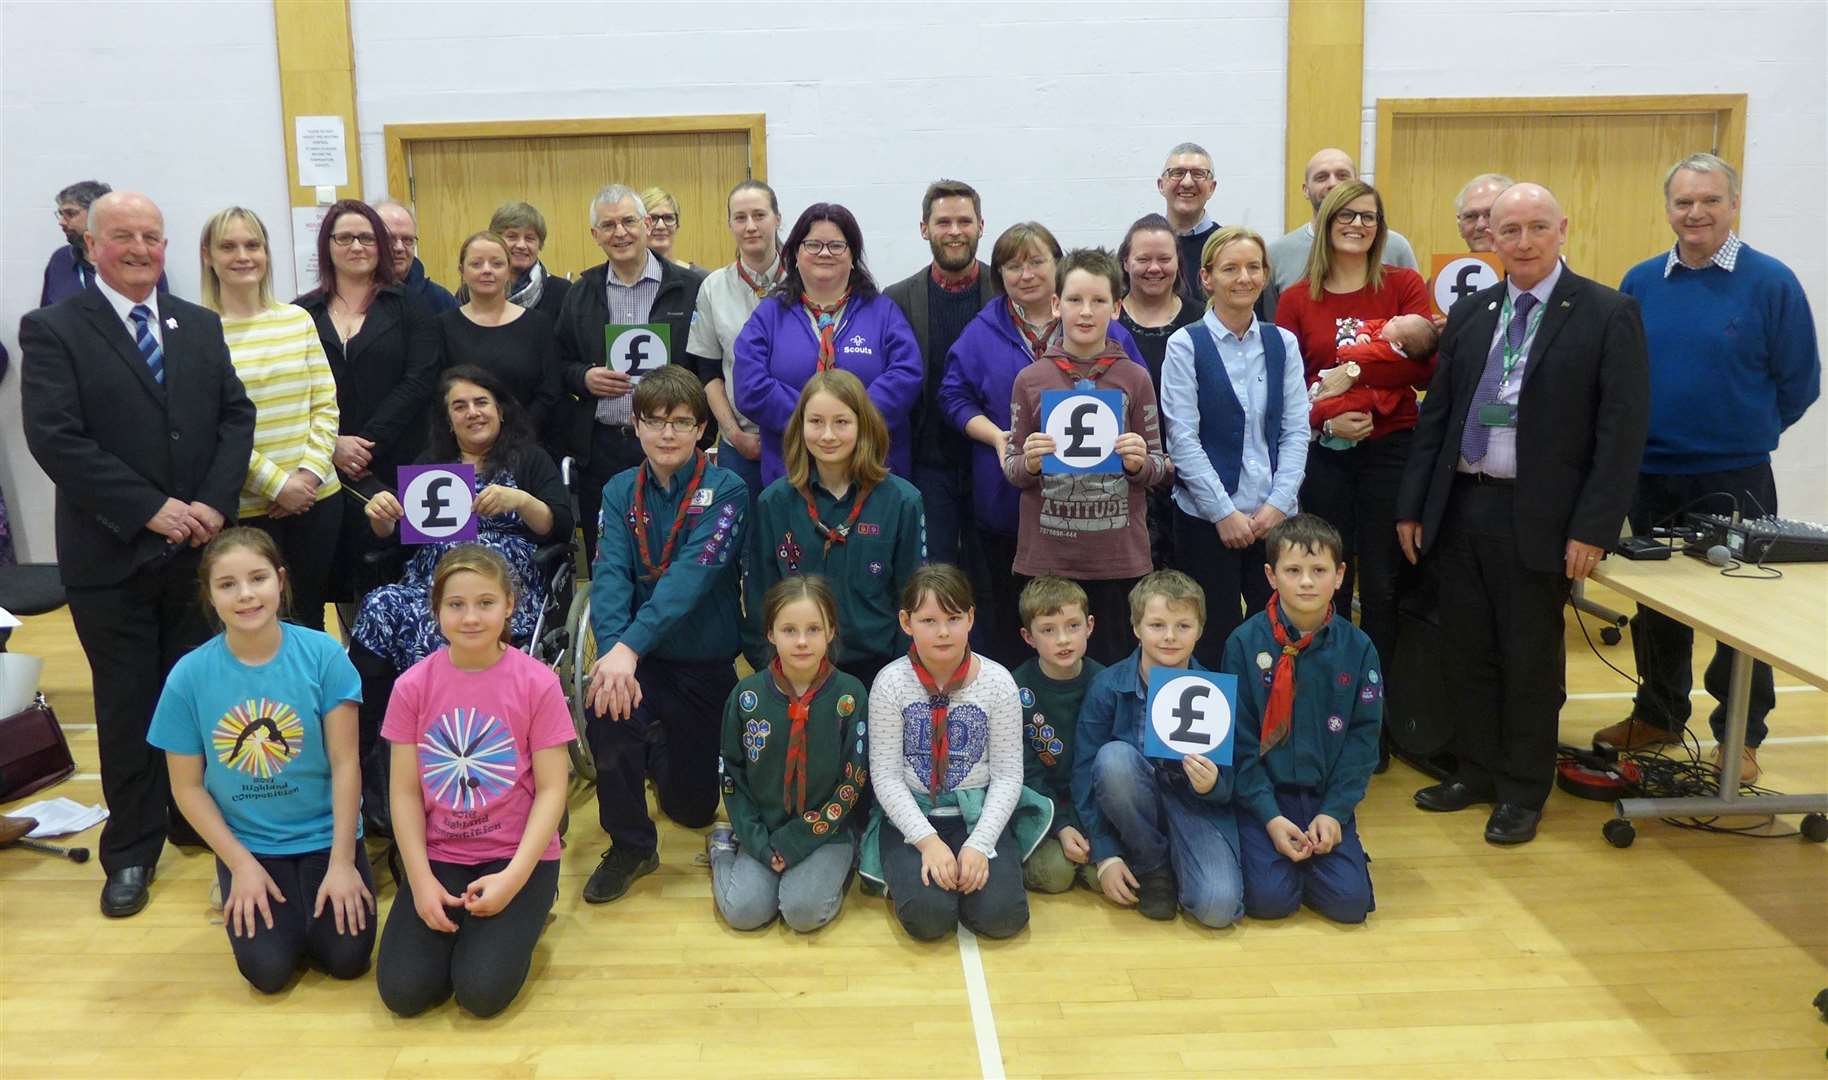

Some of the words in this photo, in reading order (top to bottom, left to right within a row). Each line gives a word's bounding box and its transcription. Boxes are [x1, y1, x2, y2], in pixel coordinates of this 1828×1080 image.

[844, 346, 872, 355] Scouts
[1064, 403, 1101, 457] £
[422, 477, 457, 528] £
[1041, 498, 1128, 519] ATTITUDE
[1169, 685, 1211, 745] £
